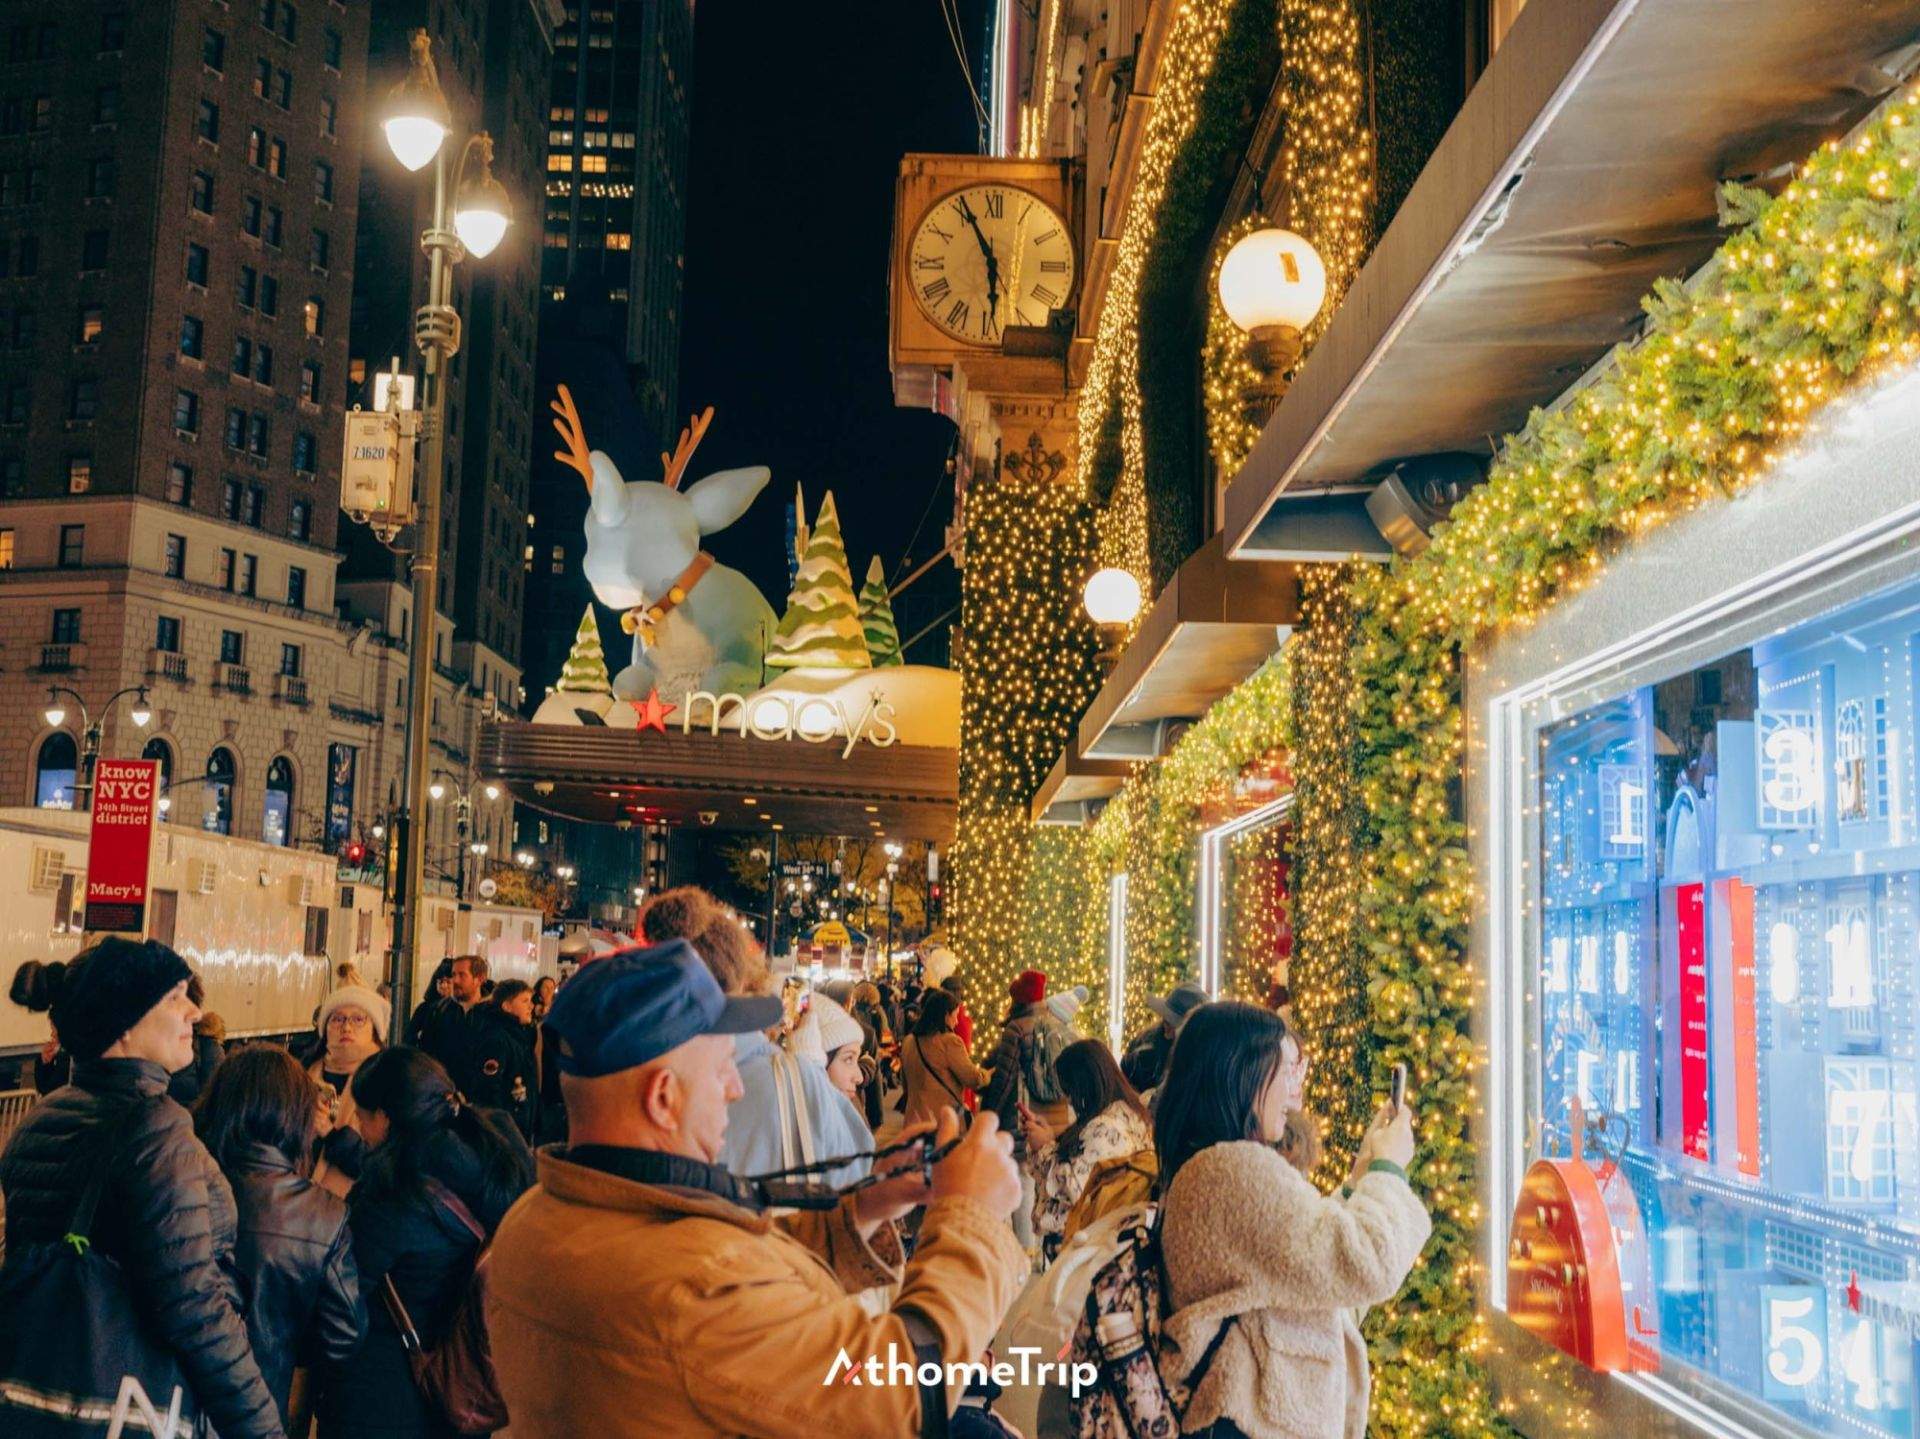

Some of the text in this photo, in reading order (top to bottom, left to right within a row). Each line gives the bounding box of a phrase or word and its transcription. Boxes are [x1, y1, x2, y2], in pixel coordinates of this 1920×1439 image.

[984, 194, 1003, 219] XII
[100, 763, 152, 780] know
[98, 781, 151, 799] NYC
[97, 803, 148, 813] 34th Street
[96, 813, 148, 826] district
[90, 883, 142, 899] Macy's
[1768, 1297, 1822, 1386] 5
